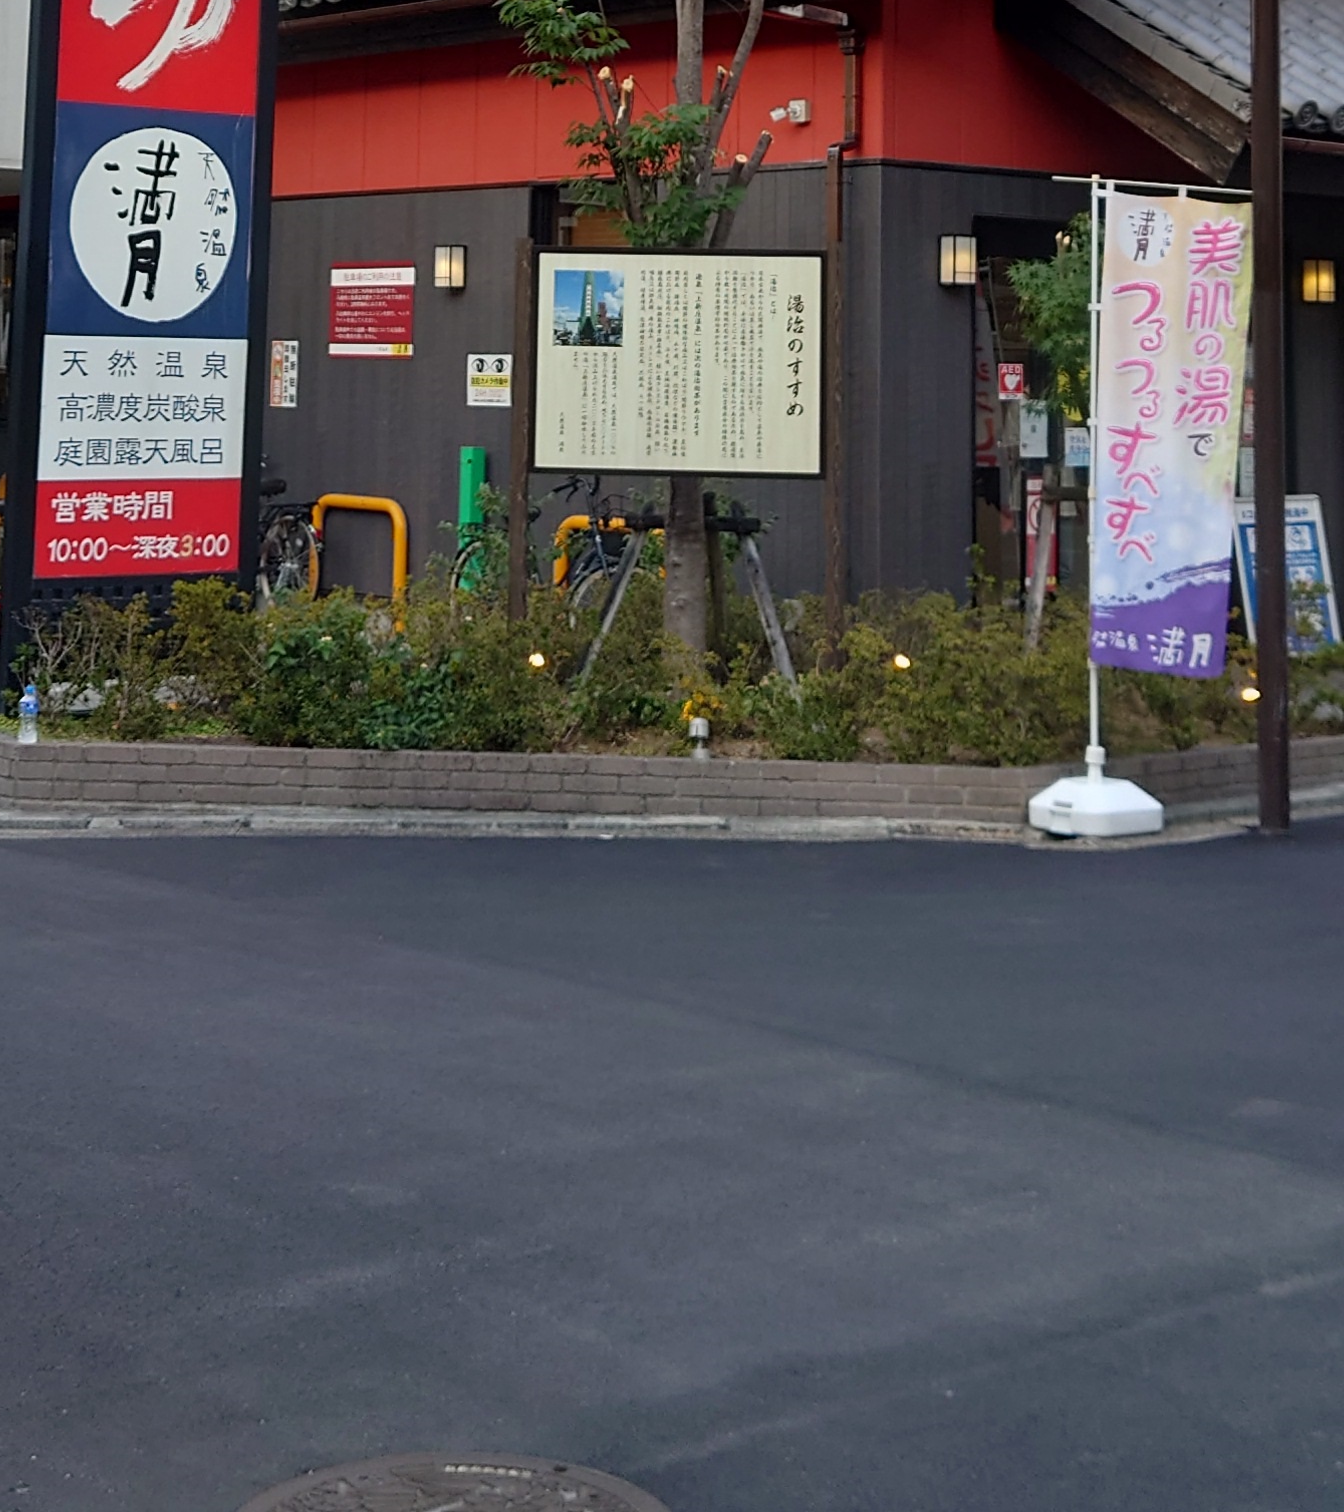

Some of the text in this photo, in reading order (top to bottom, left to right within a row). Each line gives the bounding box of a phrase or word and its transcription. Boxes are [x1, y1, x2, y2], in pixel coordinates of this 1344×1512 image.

[104, 139, 180, 307] 満月
[196, 152, 231, 294] 天然温泉
[1128, 209, 1156, 261] 満月
[786, 293, 805, 417] 湯治のすすめ
[1175, 219, 1244, 458] 美肌の湯で
[59, 349, 229, 379] 天然温泉
[1000, 365, 1021, 374] AED
[57, 392, 227, 423] 高濃度炭酸泉
[1105, 281, 1165, 564] つるつるすべすべ
[53, 437, 224, 467] 庭園露天風呂
[51, 491, 174, 523] 営業時間
[1145, 626, 1213, 668] 満月
